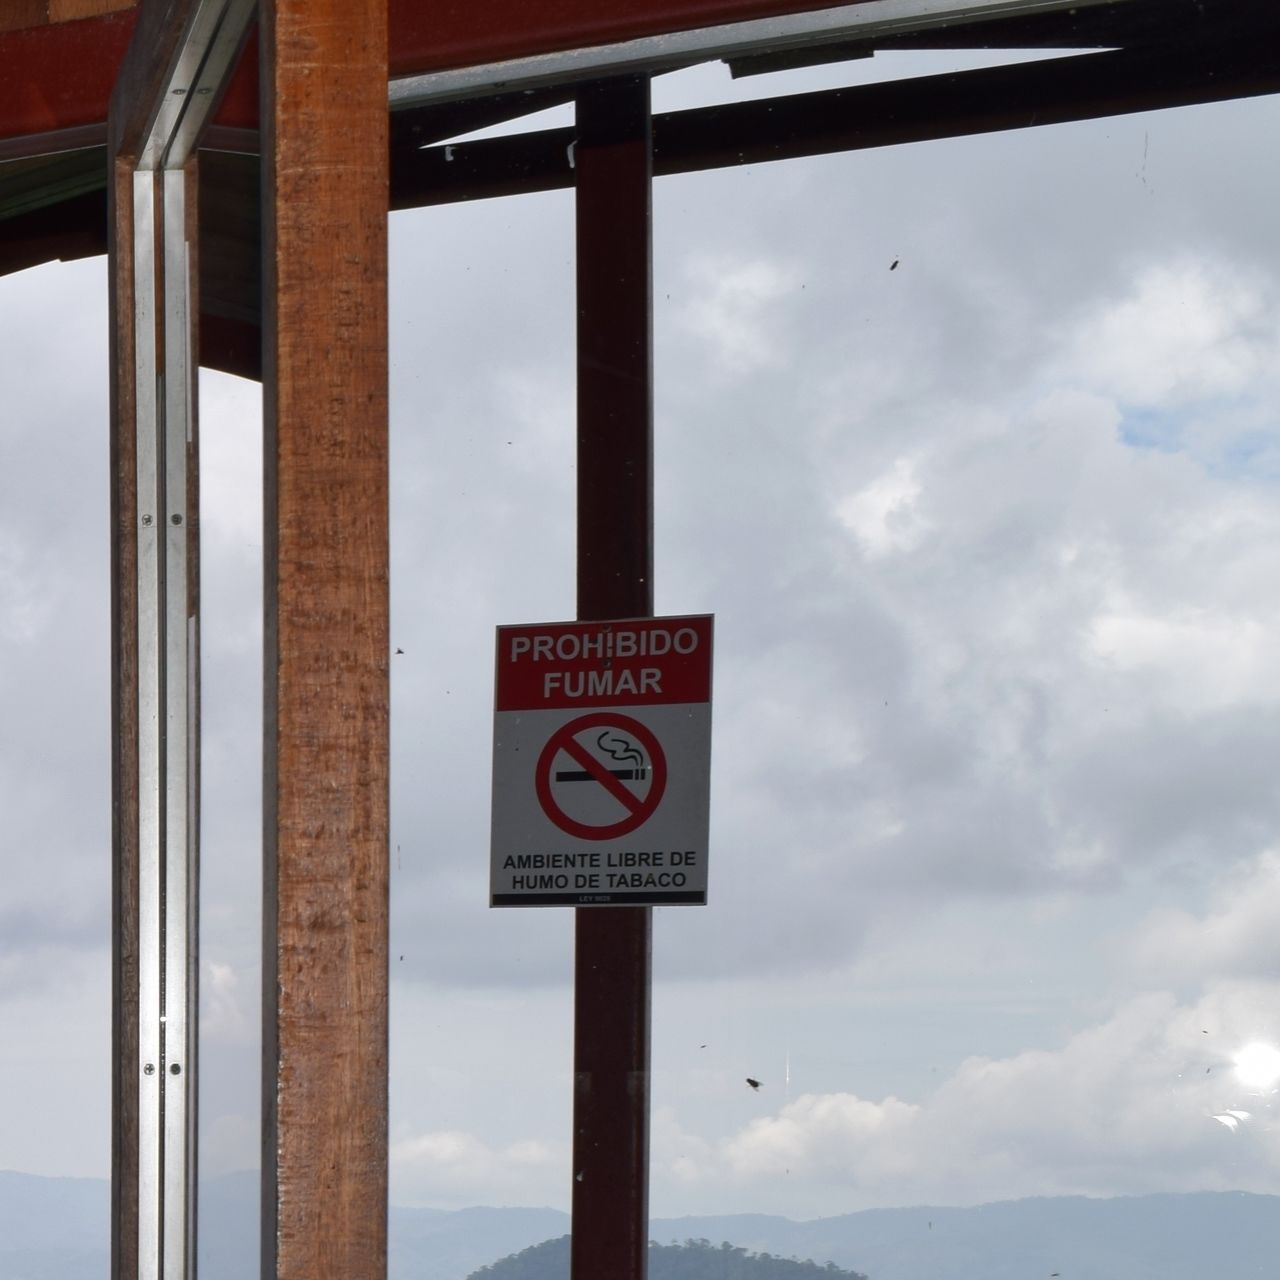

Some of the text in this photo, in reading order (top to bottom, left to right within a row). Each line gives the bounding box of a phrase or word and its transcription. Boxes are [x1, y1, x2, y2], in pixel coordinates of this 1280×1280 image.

[510, 627, 699, 662] PROHIBIDO
[543, 667, 663, 698] FUMAR
[503, 850, 697, 869] AMBIENTE LIBRE DE
[512, 871, 687, 890] HUMO DE TABACO
